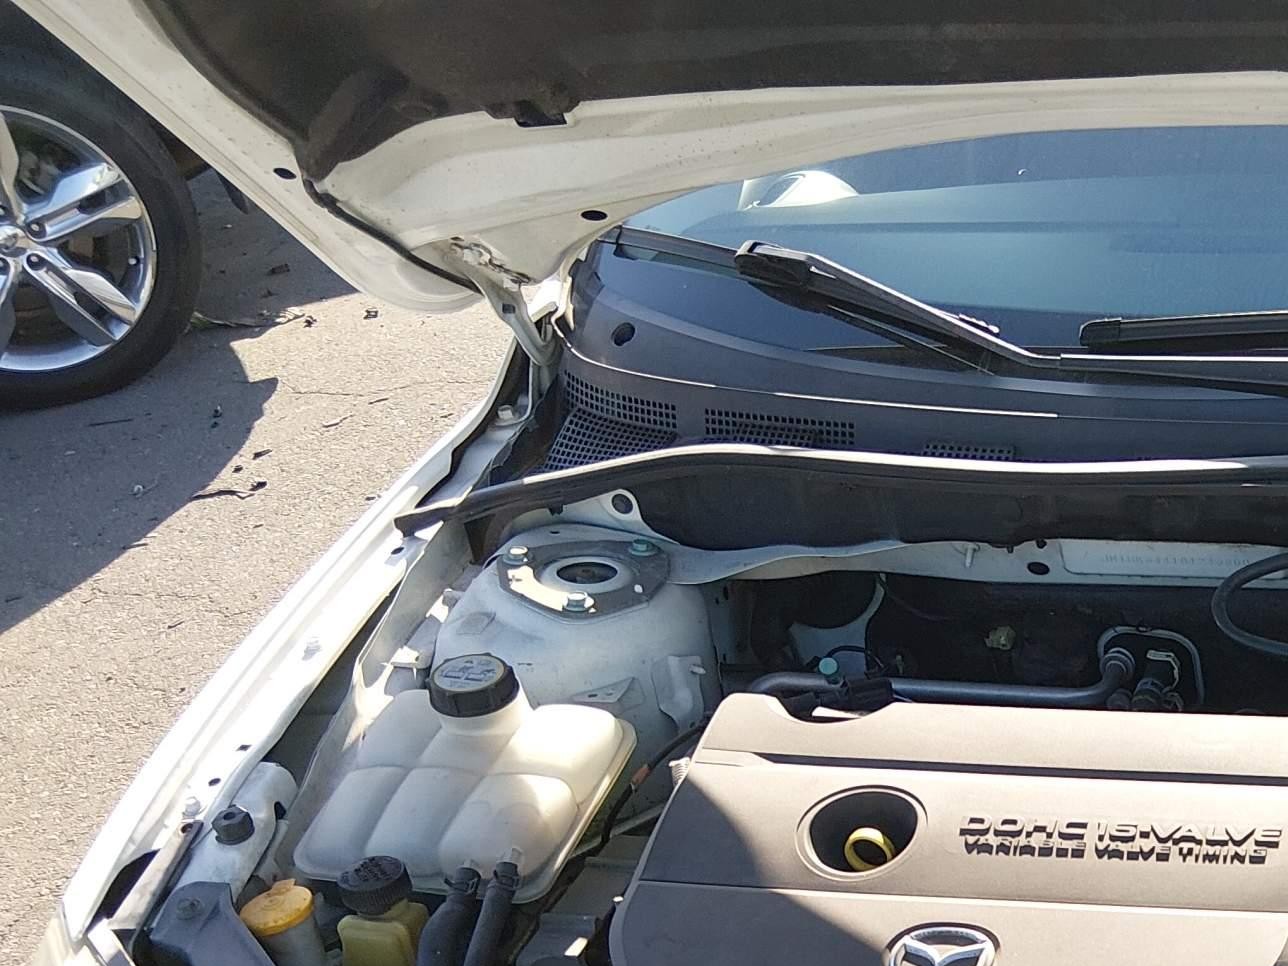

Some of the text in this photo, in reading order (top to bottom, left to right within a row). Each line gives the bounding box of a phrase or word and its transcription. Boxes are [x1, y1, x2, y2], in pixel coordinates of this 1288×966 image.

[959, 815, 1283, 848] DOHC 16-VALVE
[963, 837, 1267, 864] VARIABLE VALVE TIMING
